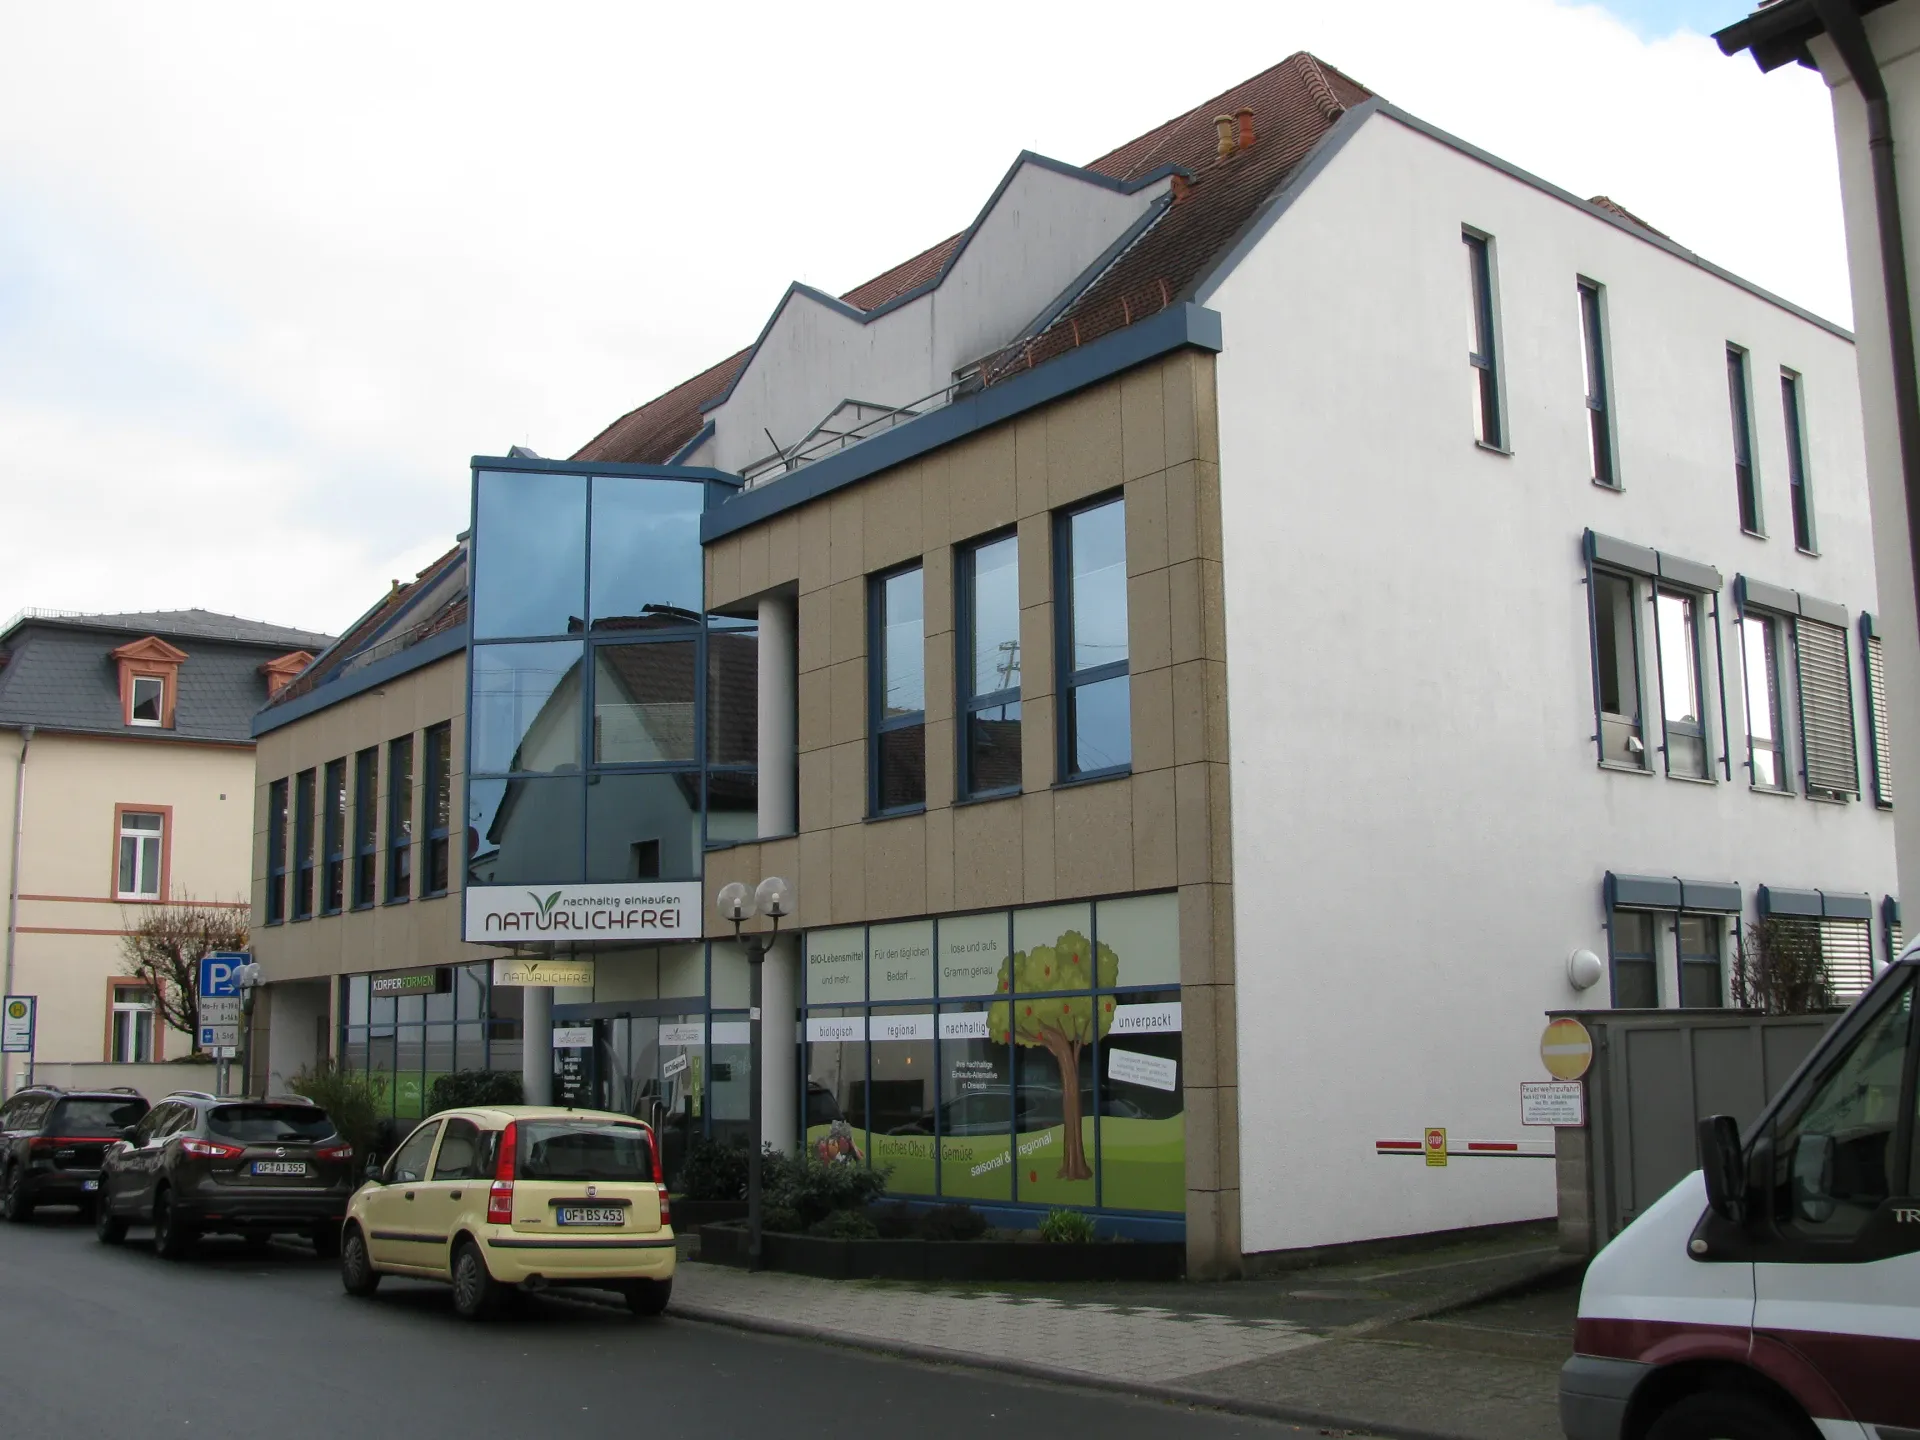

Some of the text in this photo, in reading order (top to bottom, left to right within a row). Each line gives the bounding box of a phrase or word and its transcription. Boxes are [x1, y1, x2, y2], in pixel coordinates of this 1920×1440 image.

[563, 895, 681, 908] nachhaltig einkaufen
[950, 943, 965, 954] lose
[966, 941, 980, 952] und
[981, 940, 997, 951] aufs
[810, 951, 864, 964] BIO-Lebensmittel
[874, 949, 885, 960] Für
[886, 949, 899, 959] den
[210, 963, 232, 994] P
[886, 970, 908, 982] Bedarf
[943, 966, 970, 978] Gramm
[821, 975, 833, 985] und
[1118, 1013, 1171, 1029] unverpackt
[819, 1026, 853, 1039] biologisch
[887, 1024, 917, 1038] regional
[945, 1021, 986, 1035] nachhaltig
[1522, 1084, 1580, 1093] Feuerwehrzufahrt
[1428, 1136, 1443, 1145] STOP
[941, 1144, 973, 1161] Gemüse
[970, 1154, 1004, 1177] saisonal
[1018, 1131, 1053, 1156] regional
[287, 1163, 304, 1173] 355
[564, 1209, 623, 1221] OF BS 453
